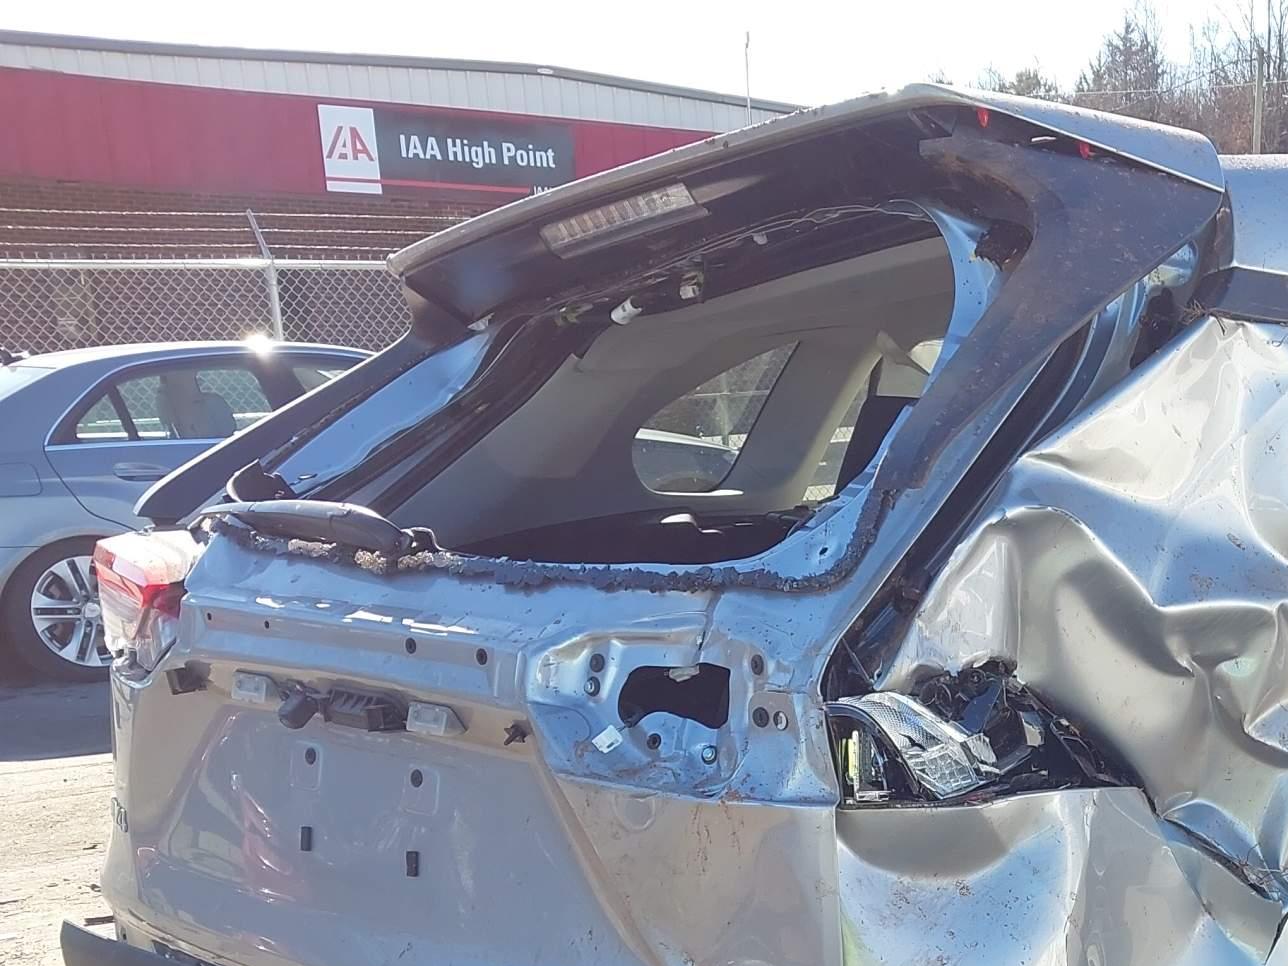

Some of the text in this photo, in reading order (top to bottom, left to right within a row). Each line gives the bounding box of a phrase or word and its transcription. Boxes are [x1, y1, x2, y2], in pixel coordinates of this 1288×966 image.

[399, 134, 556, 169] IAA High Point
